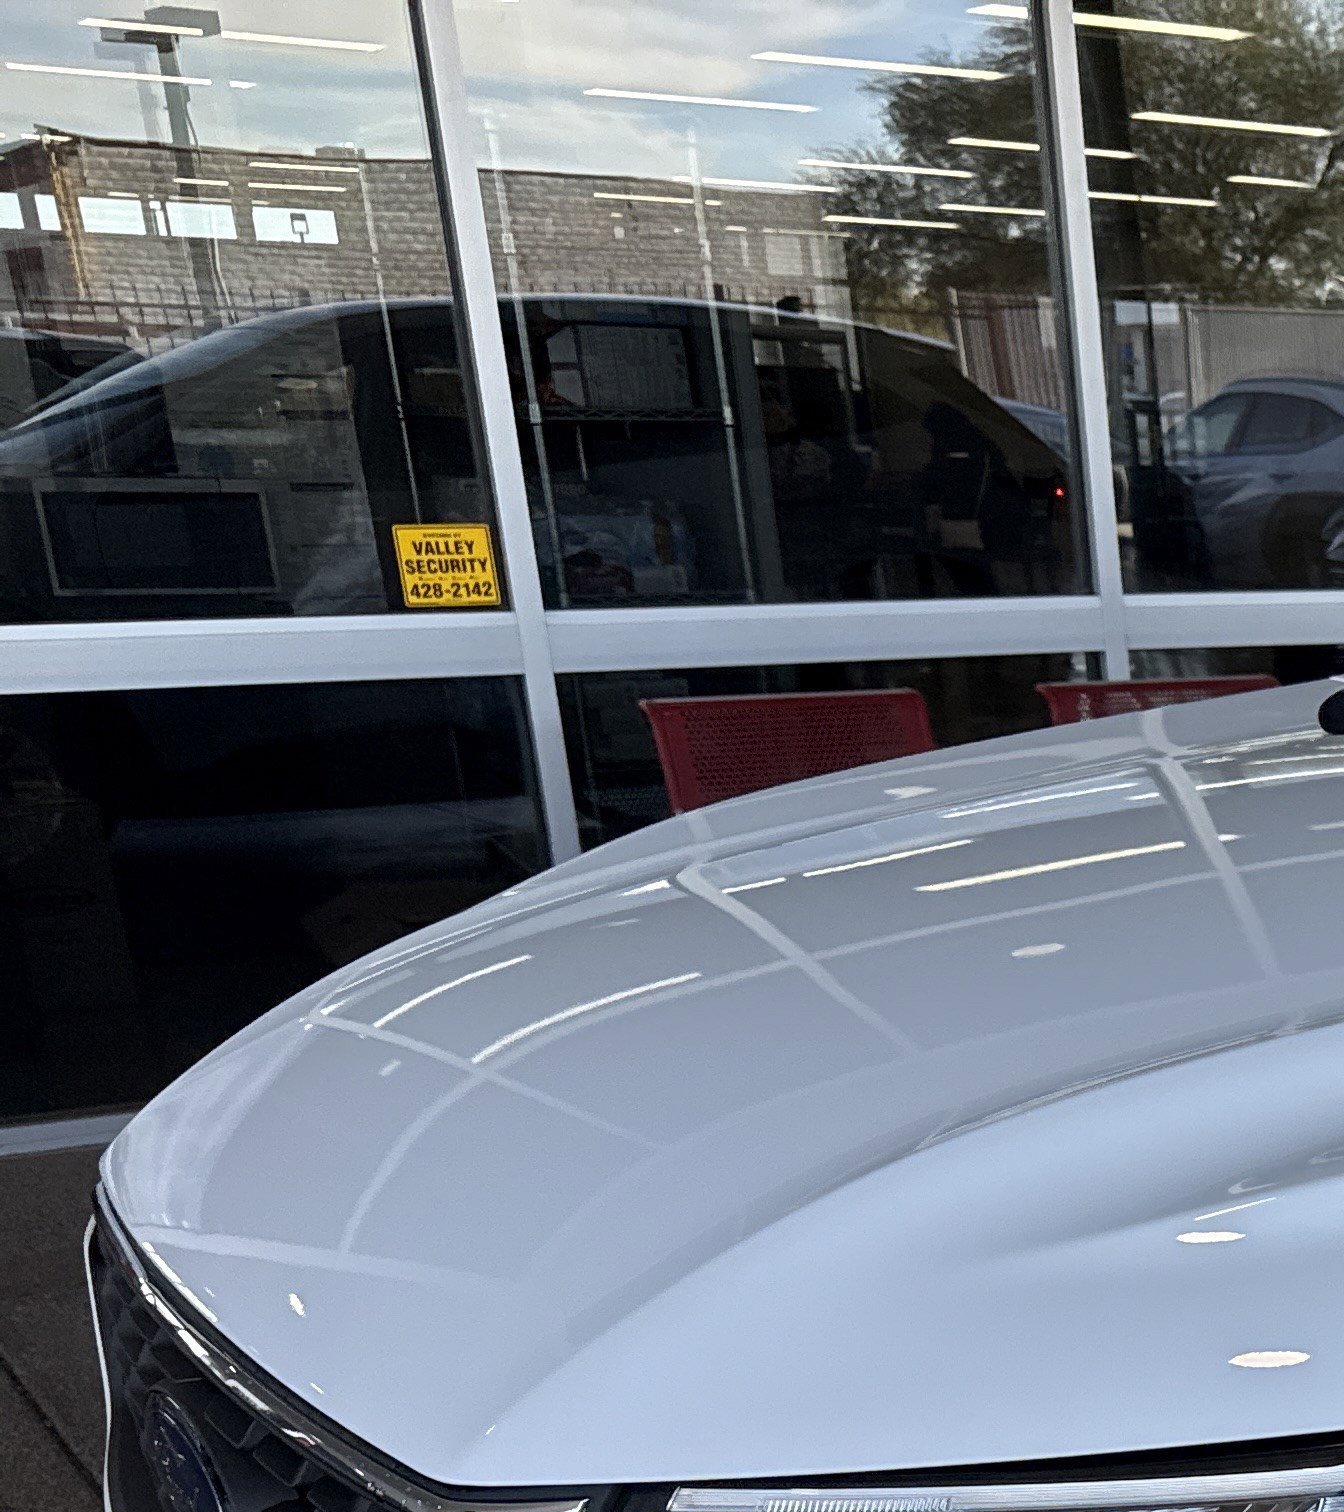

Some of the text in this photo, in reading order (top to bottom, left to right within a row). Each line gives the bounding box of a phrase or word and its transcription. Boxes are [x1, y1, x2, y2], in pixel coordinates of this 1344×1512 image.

[412, 540, 475, 555] VALLEY
[404, 558, 488, 574] SECURITY
[410, 581, 494, 599] 428-2142
